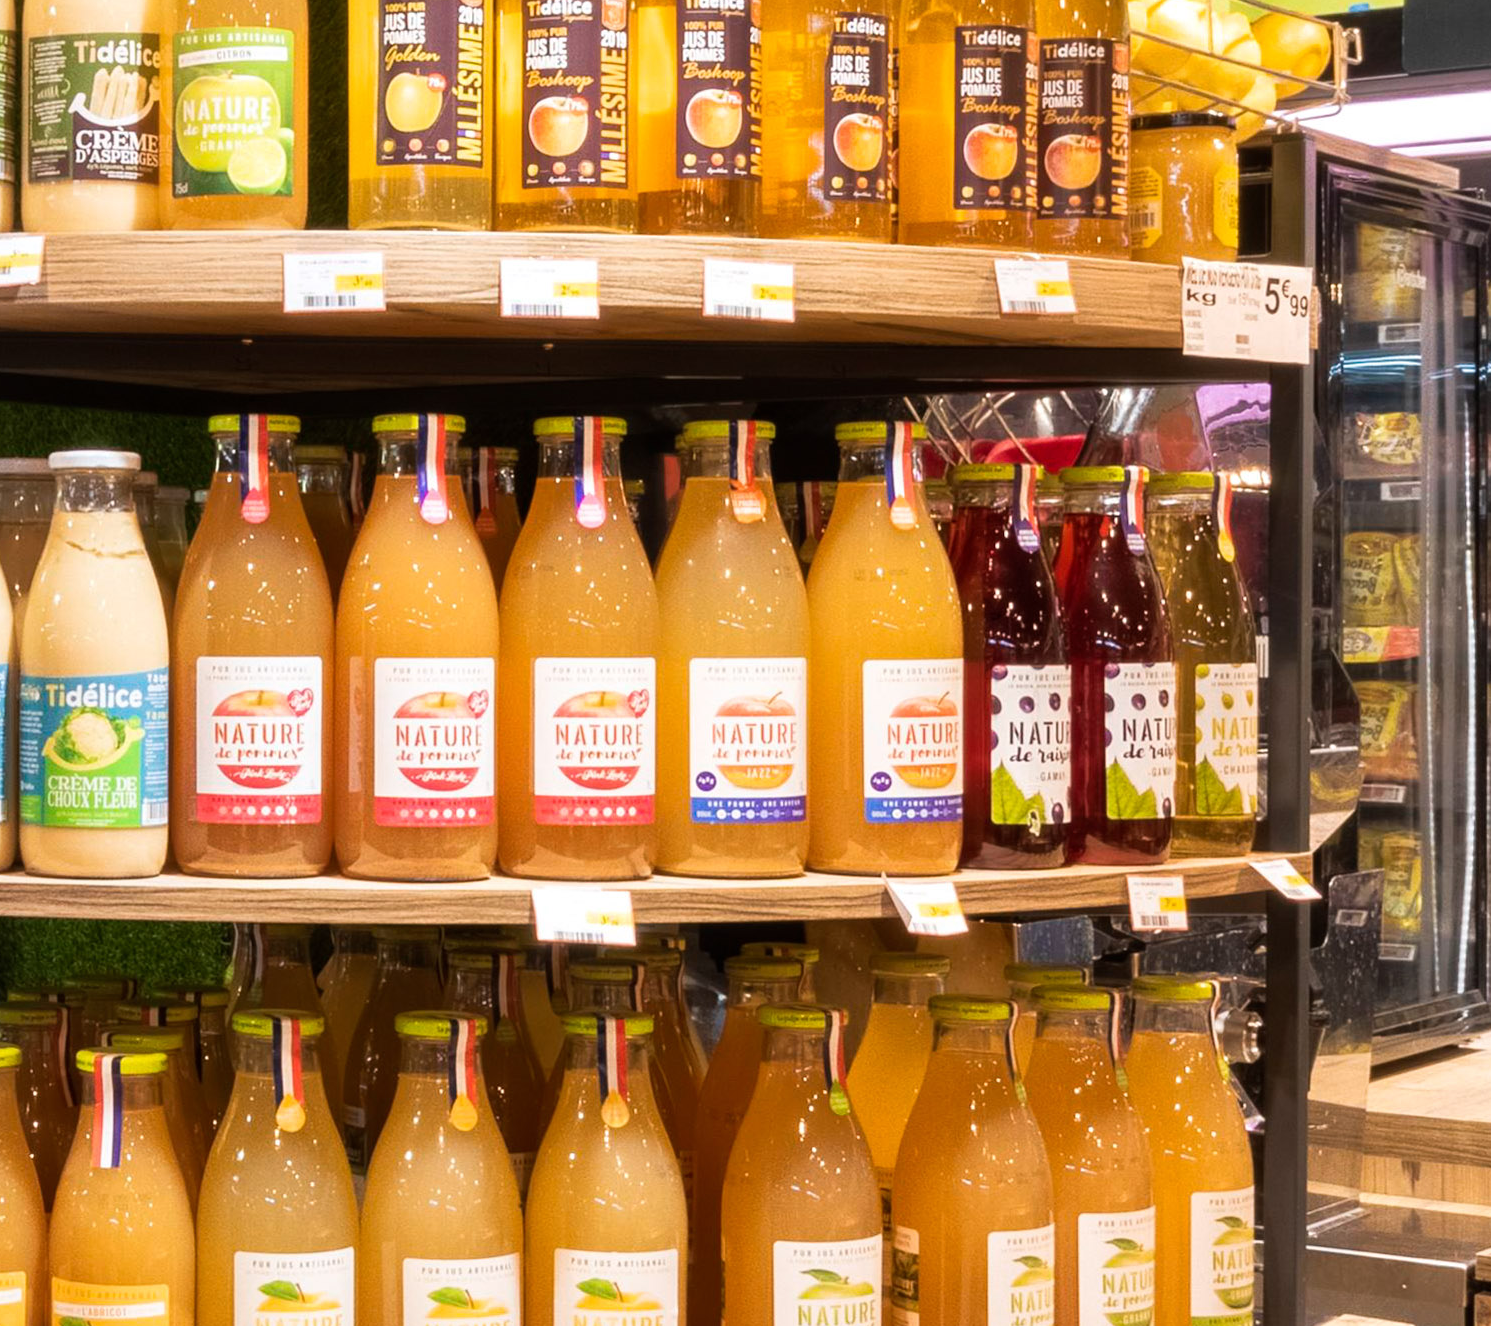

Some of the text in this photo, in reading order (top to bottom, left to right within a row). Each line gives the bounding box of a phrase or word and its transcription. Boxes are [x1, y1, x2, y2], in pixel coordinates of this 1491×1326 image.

[458, 5, 484, 24] 2019
[527, 0, 592, 17] Tidélice
[383, 12, 425, 31] JUS DE
[383, 30, 426, 45] POMMES
[600, 29, 627, 50] 2019
[682, 30, 725, 50] JUS DE
[962, 30, 1021, 46] Tidélice
[526, 38, 567, 57] JUS DE
[682, 48, 725, 62] POMMES
[1044, 43, 1105, 59] Tidélice
[385, 44, 440, 72] Golden
[526, 55, 567, 70] POMMES
[830, 56, 853, 72] JUS
[526, 70, 594, 98] Boskoop
[682, 63, 746, 86] Boskoop
[830, 72, 869, 86] POMMES
[960, 68, 984, 84] JUS
[1042, 79, 1064, 96] JUS
[831, 86, 886, 110] Boskoop
[183, 96, 272, 123] NATURE
[961, 98, 1022, 121] Boskoop
[75, 148, 158, 167] D'ASPERGES
[1186, 289, 1216, 306] kg
[46, 683, 142, 708] Tidélice
[214, 722, 305, 746] NATURE
[395, 724, 483, 747] NATURE
[555, 723, 643, 746] NATURE
[712, 721, 798, 745] NATURE
[1212, 717, 1257, 740] NATU
[1010, 747, 1033, 763] de
[1122, 743, 1145, 759] de
[47, 773, 137, 792] CRÈME DE
[47, 791, 137, 809] CHOUX FLEUR
[1010, 1289, 1054, 1315] NATU
